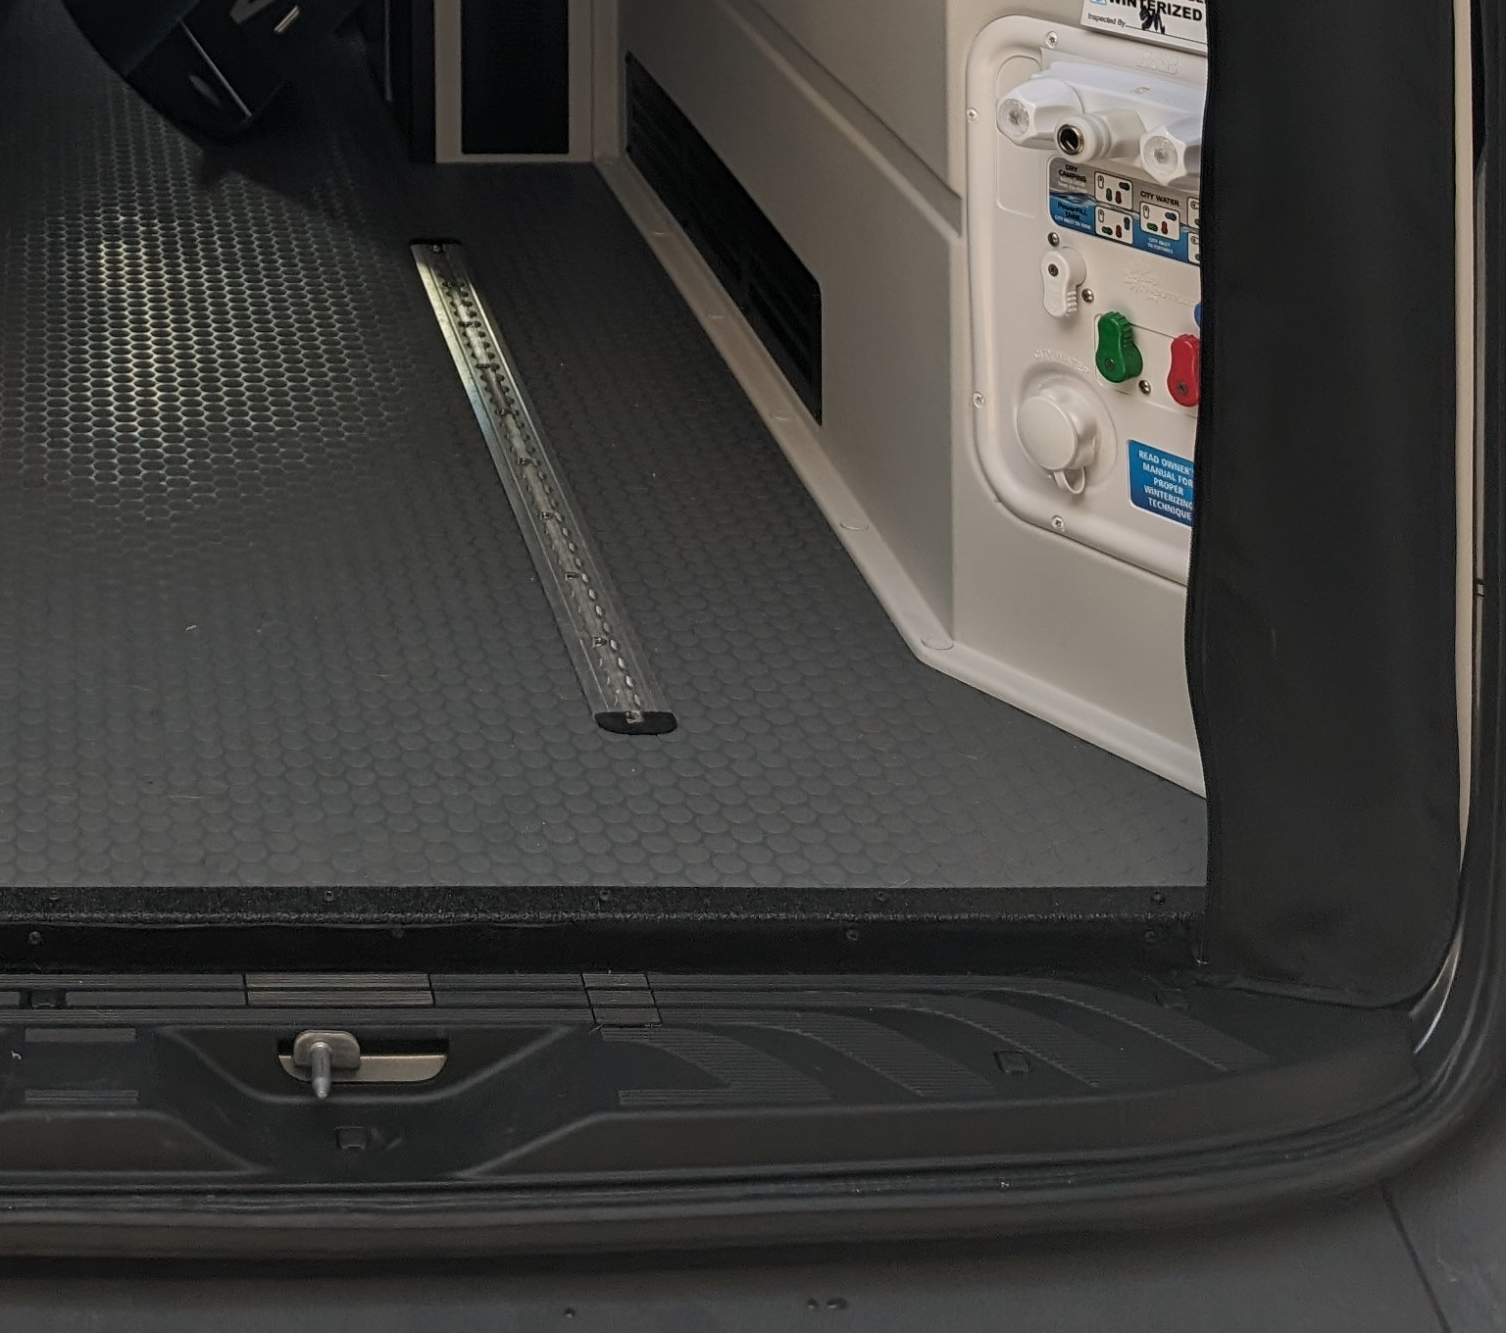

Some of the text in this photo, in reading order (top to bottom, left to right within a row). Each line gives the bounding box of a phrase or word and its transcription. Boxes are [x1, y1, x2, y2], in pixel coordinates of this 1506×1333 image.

[1087, 12, 1126, 28] Inspected By
[1140, 190, 1180, 206] CITY WATER
[1138, 449, 1194, 475] READ OWNER'
[1142, 462, 1194, 488] MANUAL FOR
[1153, 477, 1184, 496] PROPER
[1148, 497, 1192, 521] TECHNIQUE
